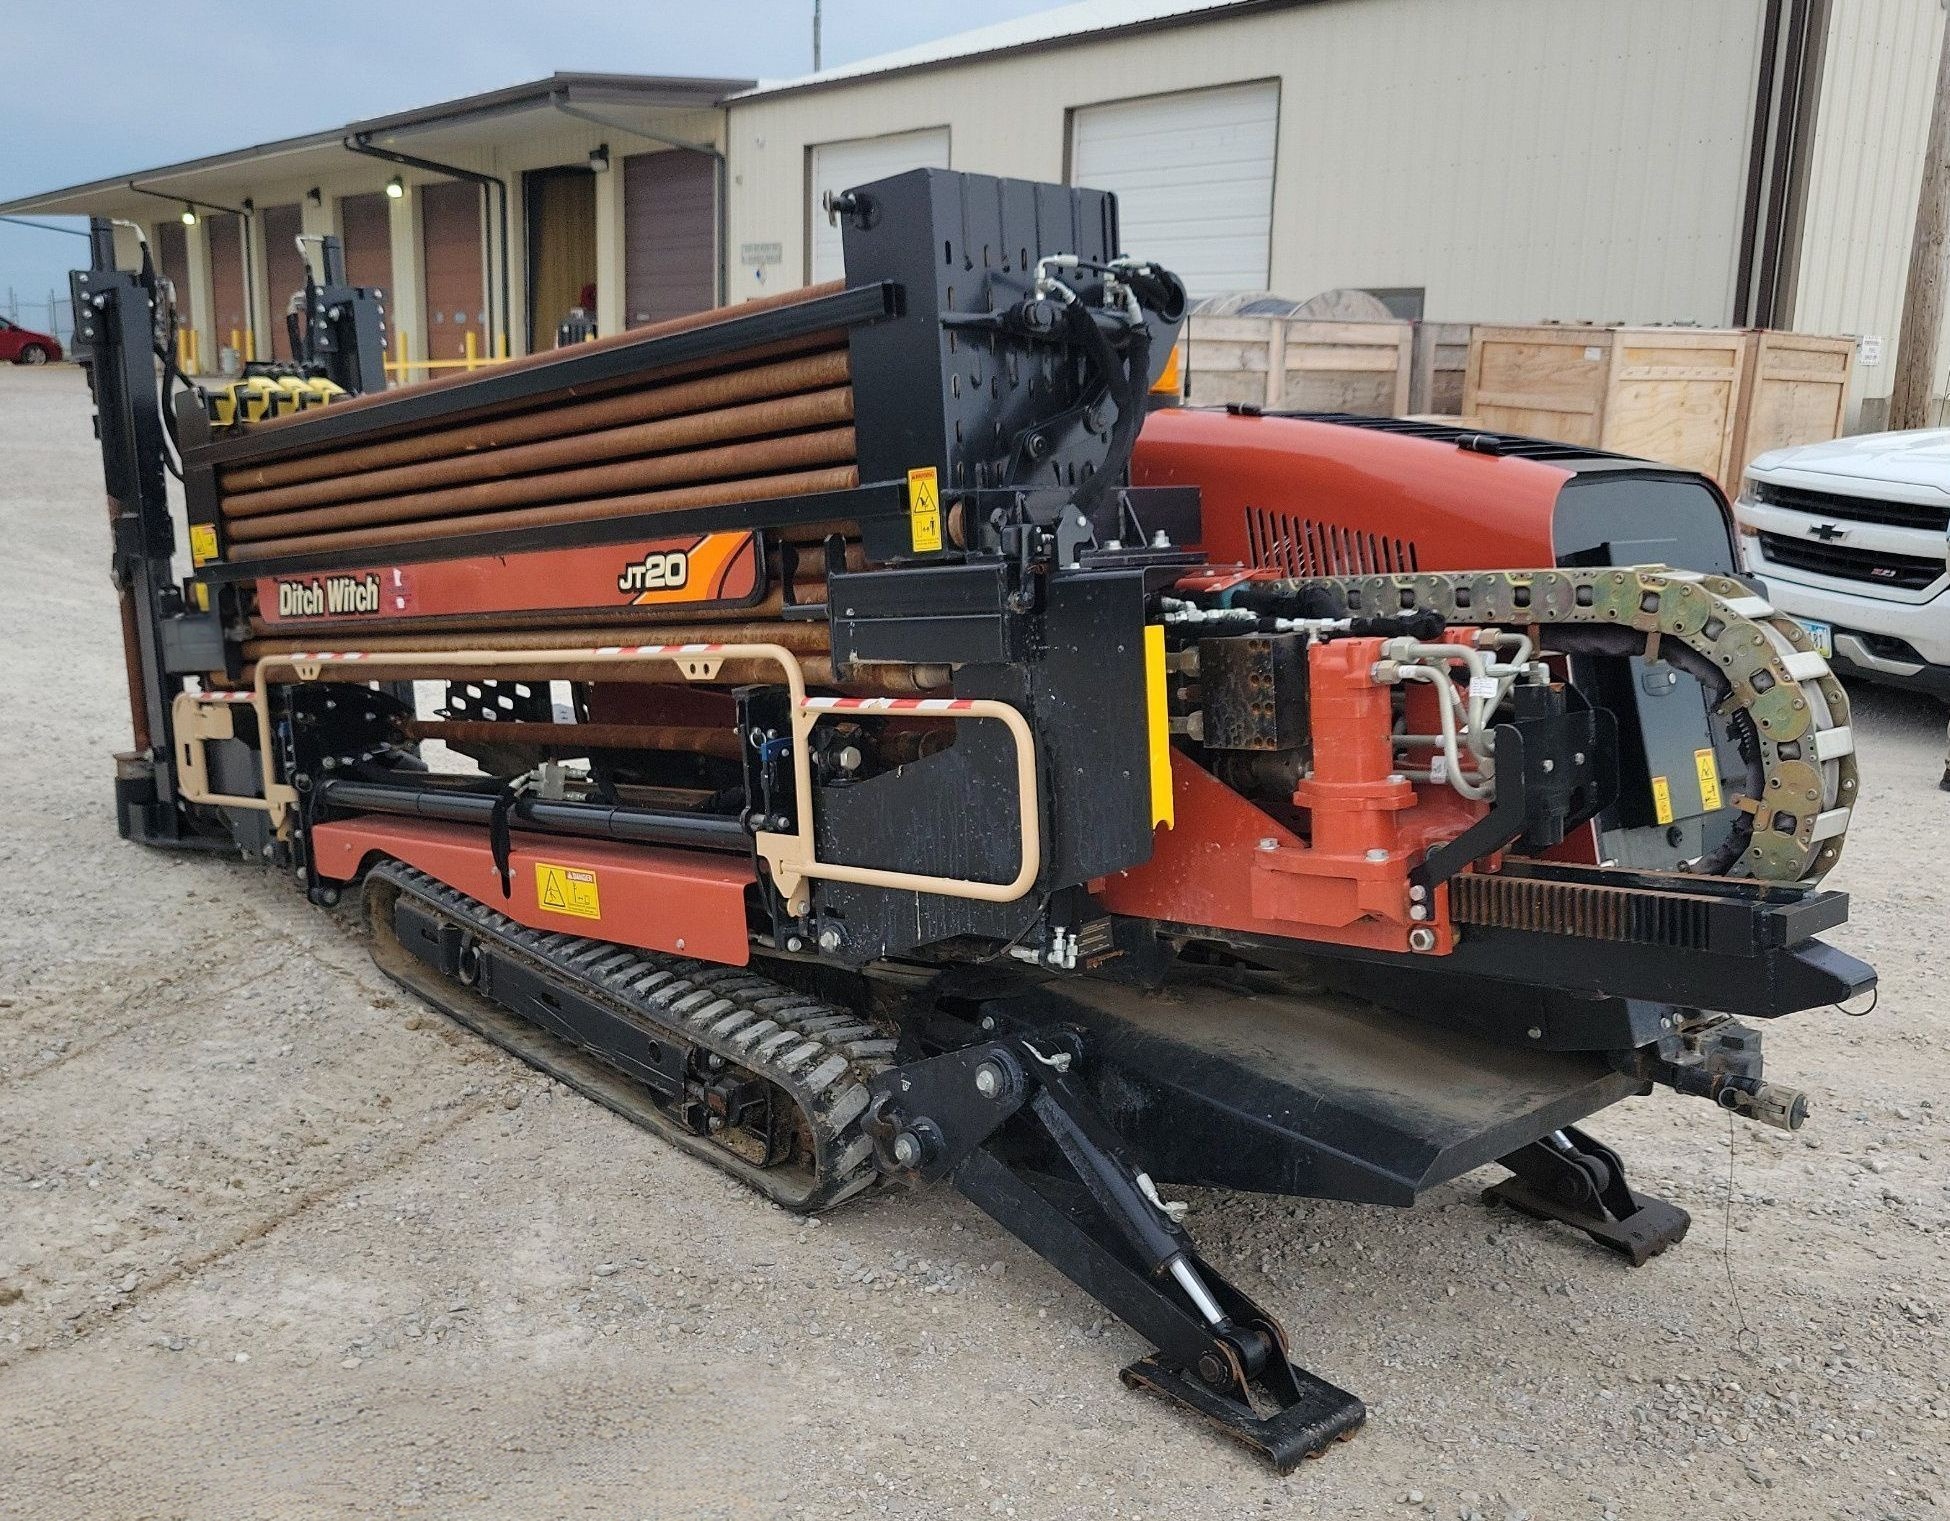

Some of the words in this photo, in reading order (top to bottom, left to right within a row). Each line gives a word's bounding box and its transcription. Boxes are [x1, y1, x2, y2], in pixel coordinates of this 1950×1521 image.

[618, 551, 688, 591] JT20
[279, 578, 325, 616] Ditch
[326, 574, 379, 613] Witch
